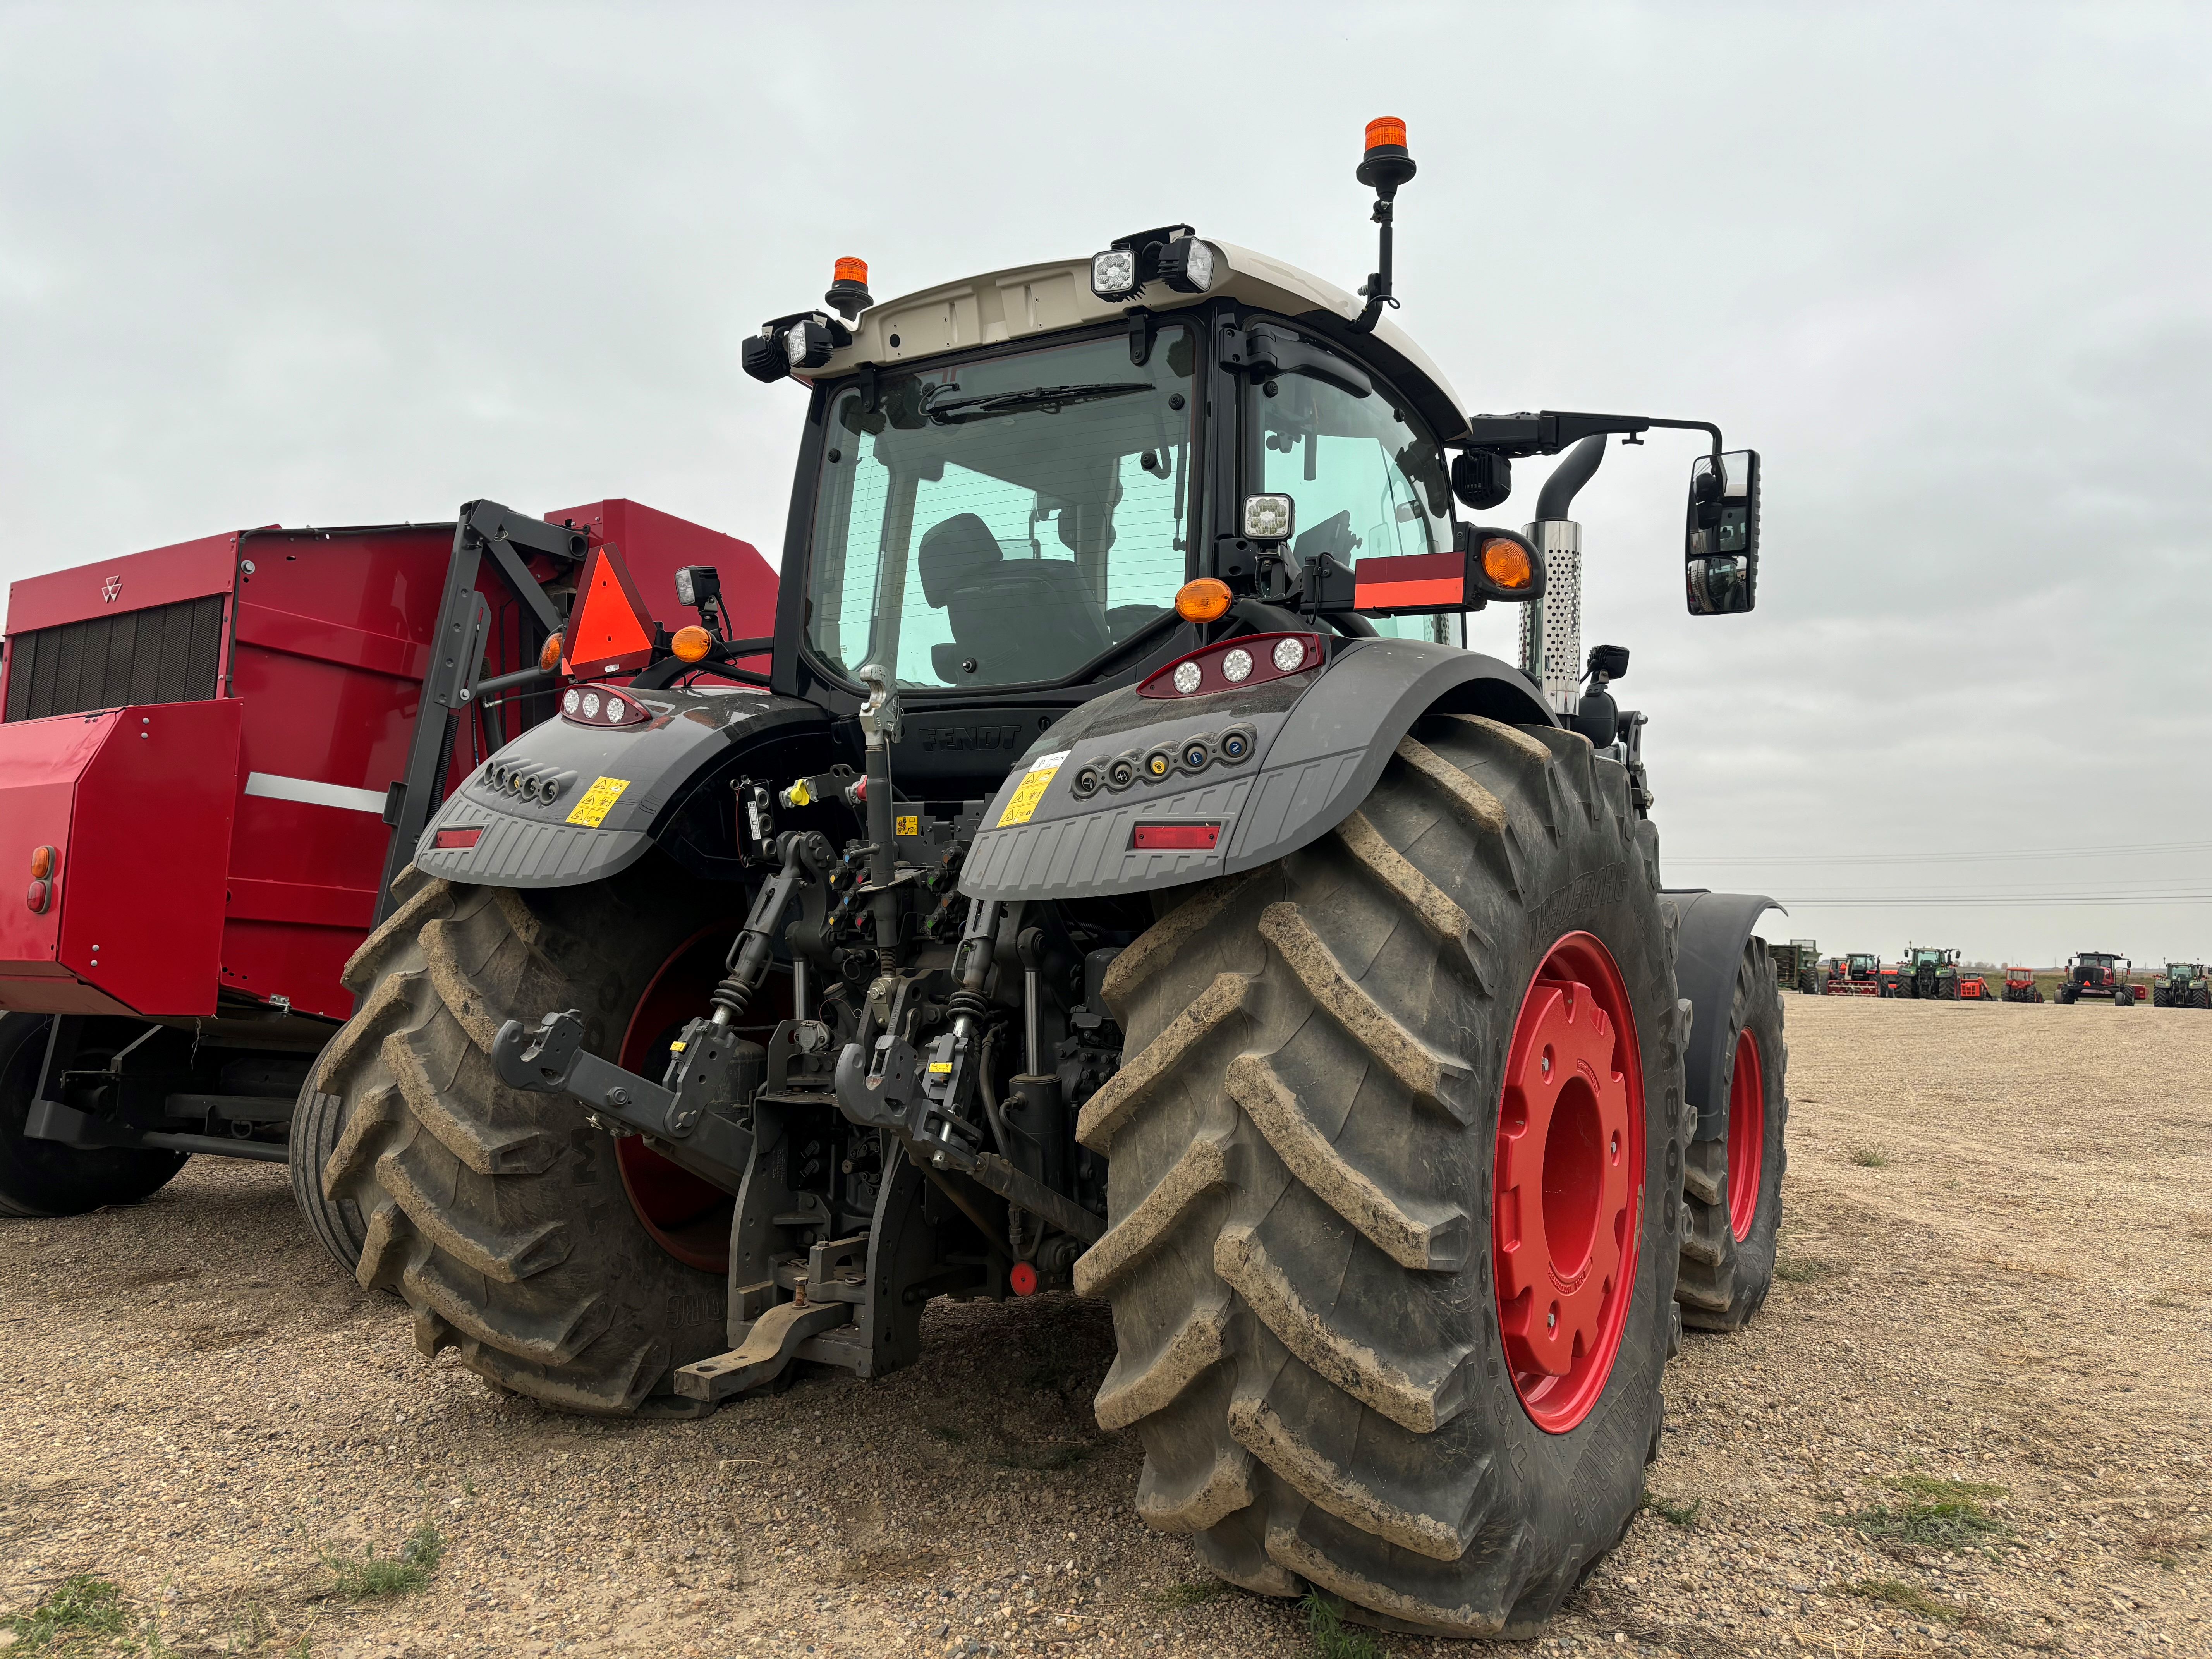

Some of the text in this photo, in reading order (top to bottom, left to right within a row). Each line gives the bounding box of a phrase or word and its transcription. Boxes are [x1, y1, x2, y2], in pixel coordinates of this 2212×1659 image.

[919, 725, 1022, 752] FENDT
[1527, 860, 1629, 954] TRELLEBORG
[571, 970, 623, 1237] TM00
[1650, 958, 1679, 1237] TM800
[1566, 1360, 1653, 1528] TRELLEBORG
